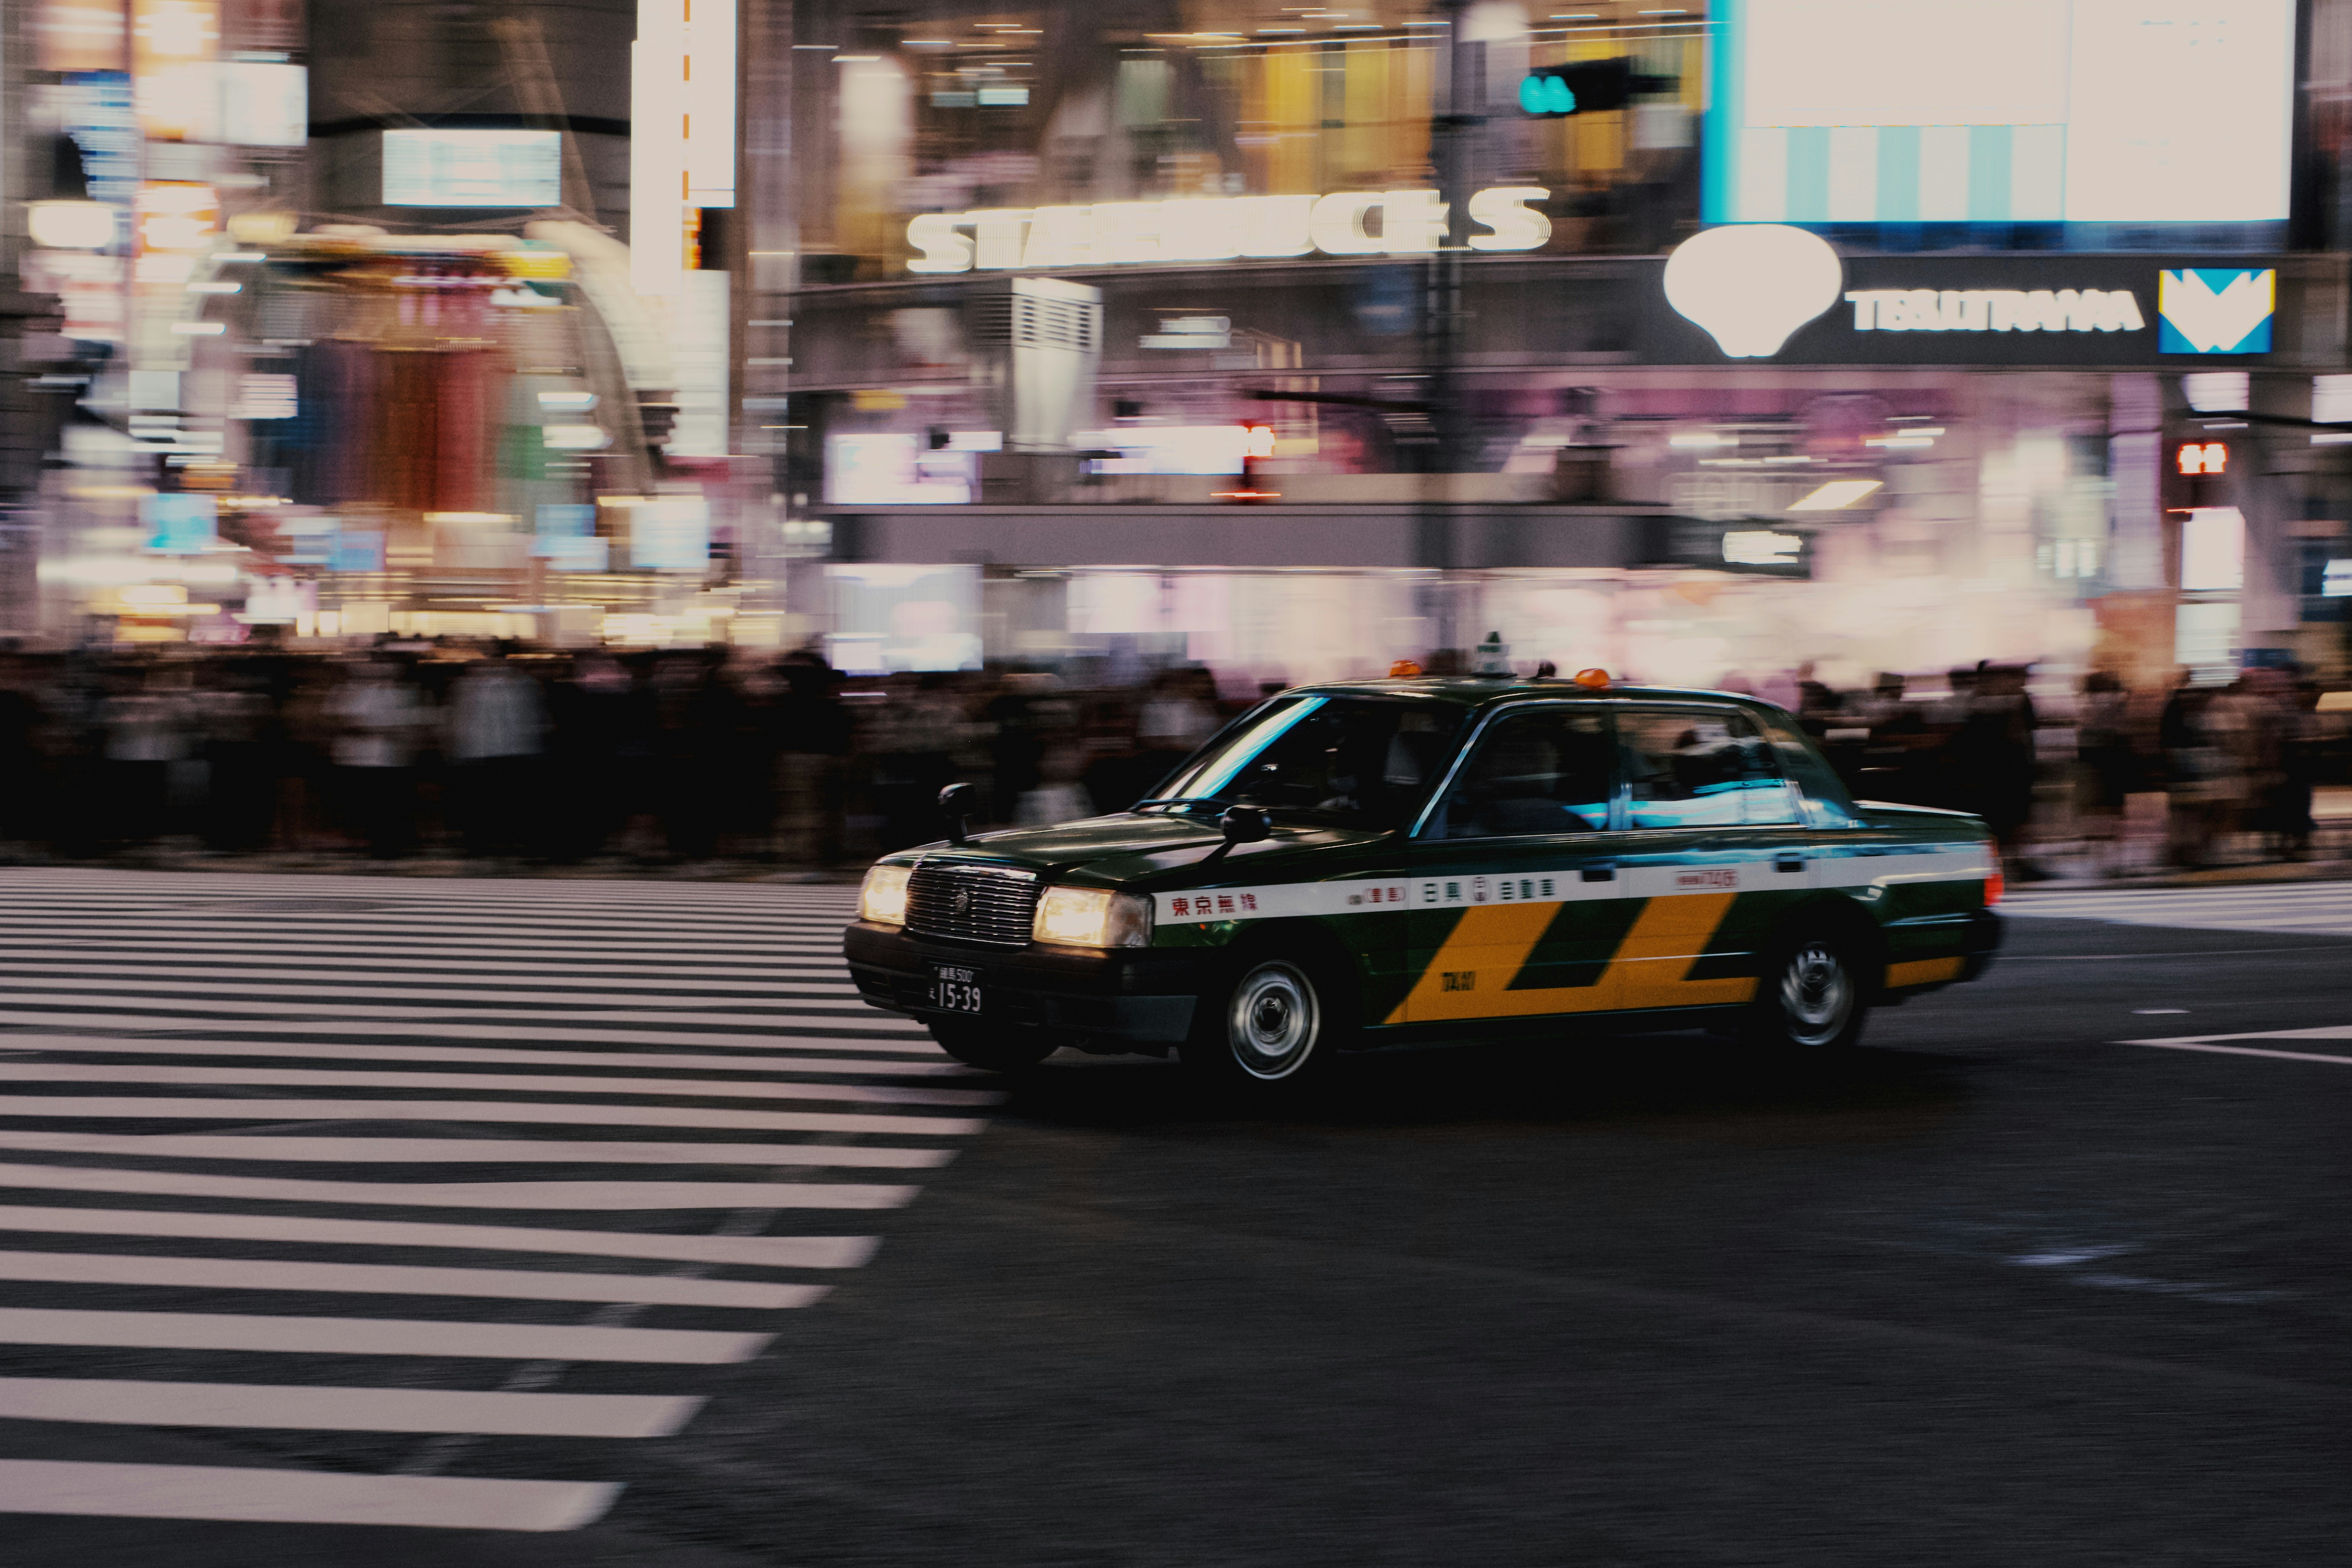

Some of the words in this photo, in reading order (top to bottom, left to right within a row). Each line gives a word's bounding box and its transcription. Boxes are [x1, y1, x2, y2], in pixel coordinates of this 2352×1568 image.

[1171, 893, 1258, 916] 東京無線
[1440, 971, 1476, 992] TAXI
[939, 982, 981, 1012] 15-39
